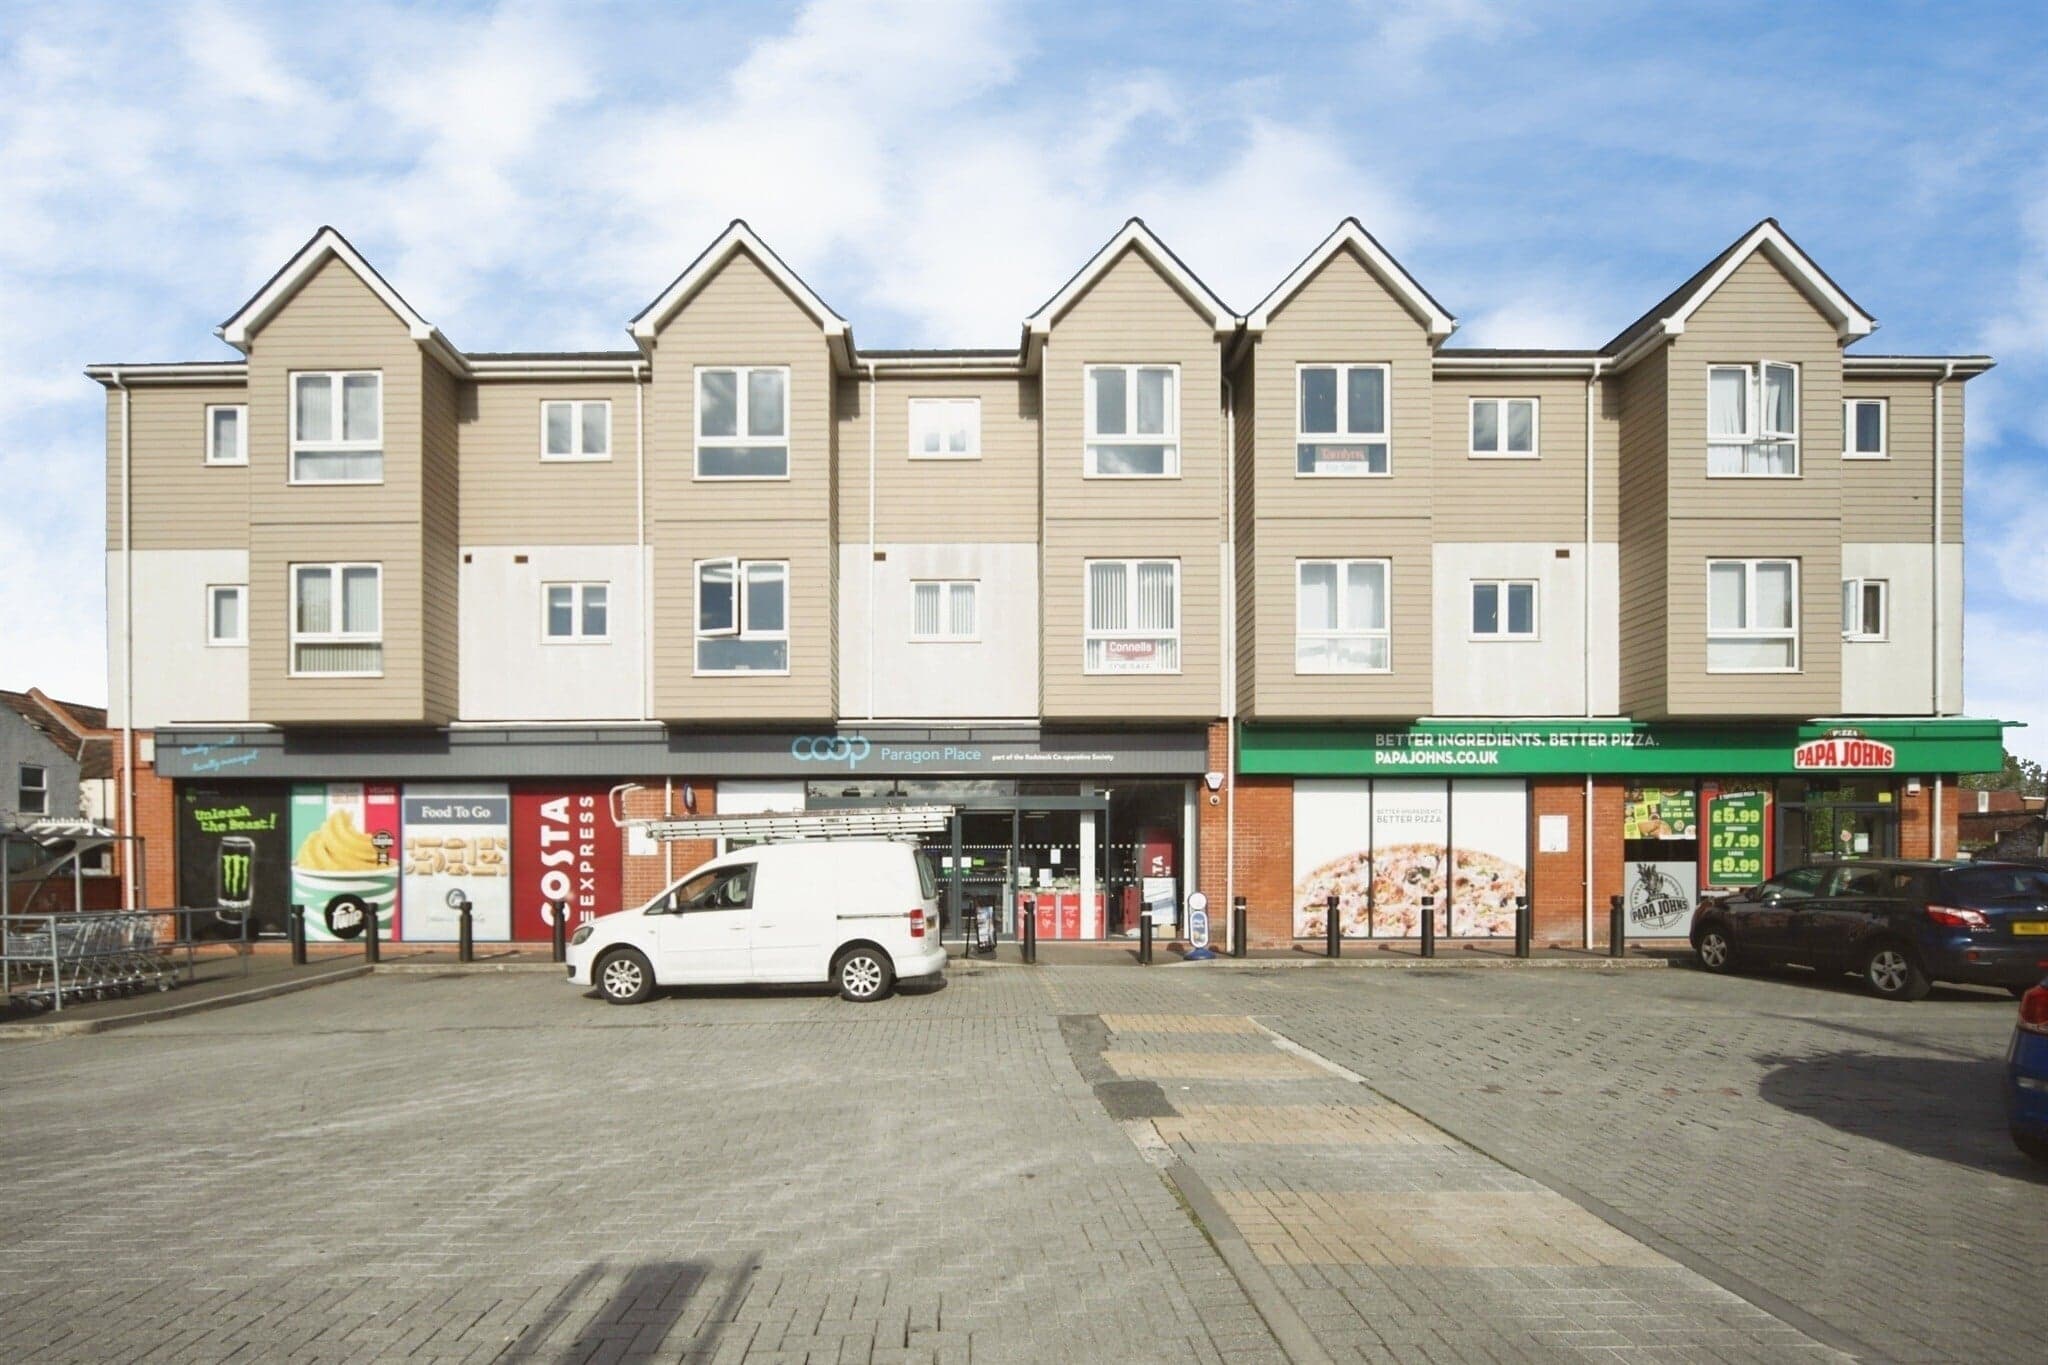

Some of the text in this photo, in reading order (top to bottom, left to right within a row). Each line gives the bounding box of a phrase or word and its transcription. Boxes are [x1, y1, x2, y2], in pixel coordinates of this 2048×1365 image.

[1375, 733, 1660, 747] BETTER INGREDIENTS. BETTER PIZZA.
[881, 747, 981, 763] Paragon Place
[1375, 751, 1498, 764] PAPAJOHNS.CO.UK
[1796, 741, 1893, 767] PAPA JOHNS
[422, 805, 491, 818] Food To Go
[1377, 815, 1412, 823] BETTER
[1712, 807, 1760, 823] £5.99
[201, 820, 227, 833] the
[1712, 831, 1760, 848] £7.99
[580, 796, 594, 906] EXPRESS
[1712, 857, 1760, 873] £9.99
[1632, 903, 1657, 921] PAPA
[1658, 899, 1688, 915] JOHNS
